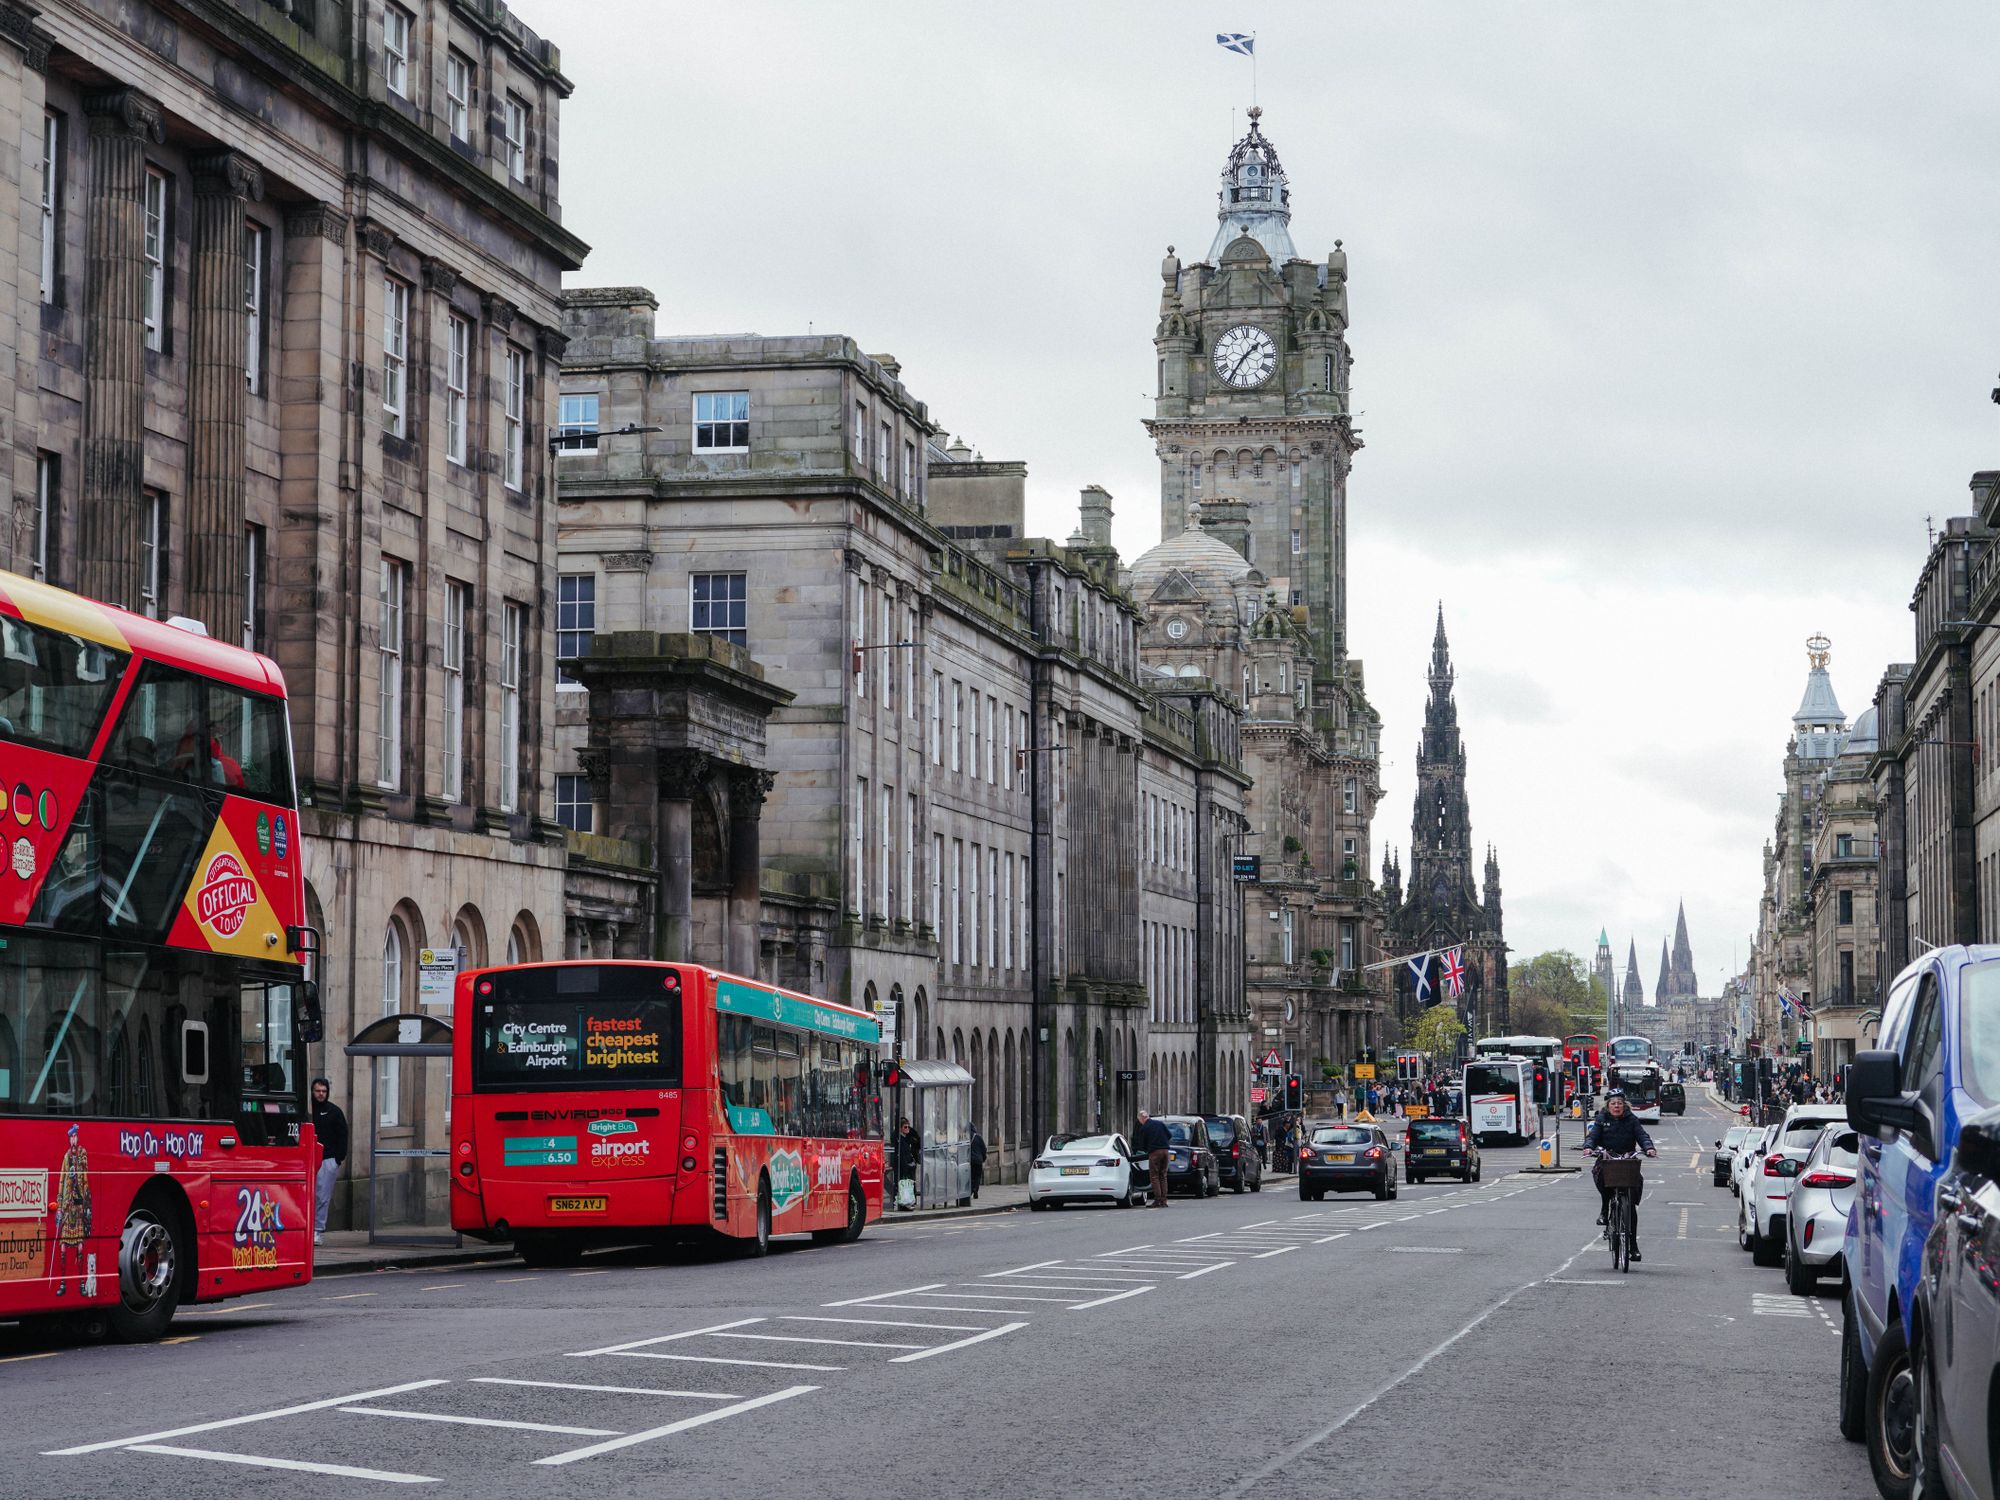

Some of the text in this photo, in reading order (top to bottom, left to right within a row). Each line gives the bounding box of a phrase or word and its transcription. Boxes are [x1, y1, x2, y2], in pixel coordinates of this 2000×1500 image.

[203, 882, 254, 916] OFFICIAL
[220, 910, 242, 932] TOUR
[503, 1022, 567, 1037] City Centre
[586, 1016, 642, 1032] fastest
[497, 1041, 567, 1055] & Edinburgh
[586, 1032, 659, 1050] cheapest
[526, 1055, 567, 1069] Airport
[586, 1050, 659, 1068] brightest
[658, 1091, 678, 1100] 8485
[287, 1122, 299, 1137] 228
[591, 1122, 633, 1132] Bright Bus
[121, 1131, 203, 1158] Hop On Hop Off
[591, 1137, 650, 1158] airport
[591, 1155, 646, 1168] express
[0, 1180, 42, 1205] ISTORIES
[555, 1200, 602, 1210] SN62 AYJ
[235, 1188, 262, 1243] 24
[253, 1244, 278, 1268] Ticket
